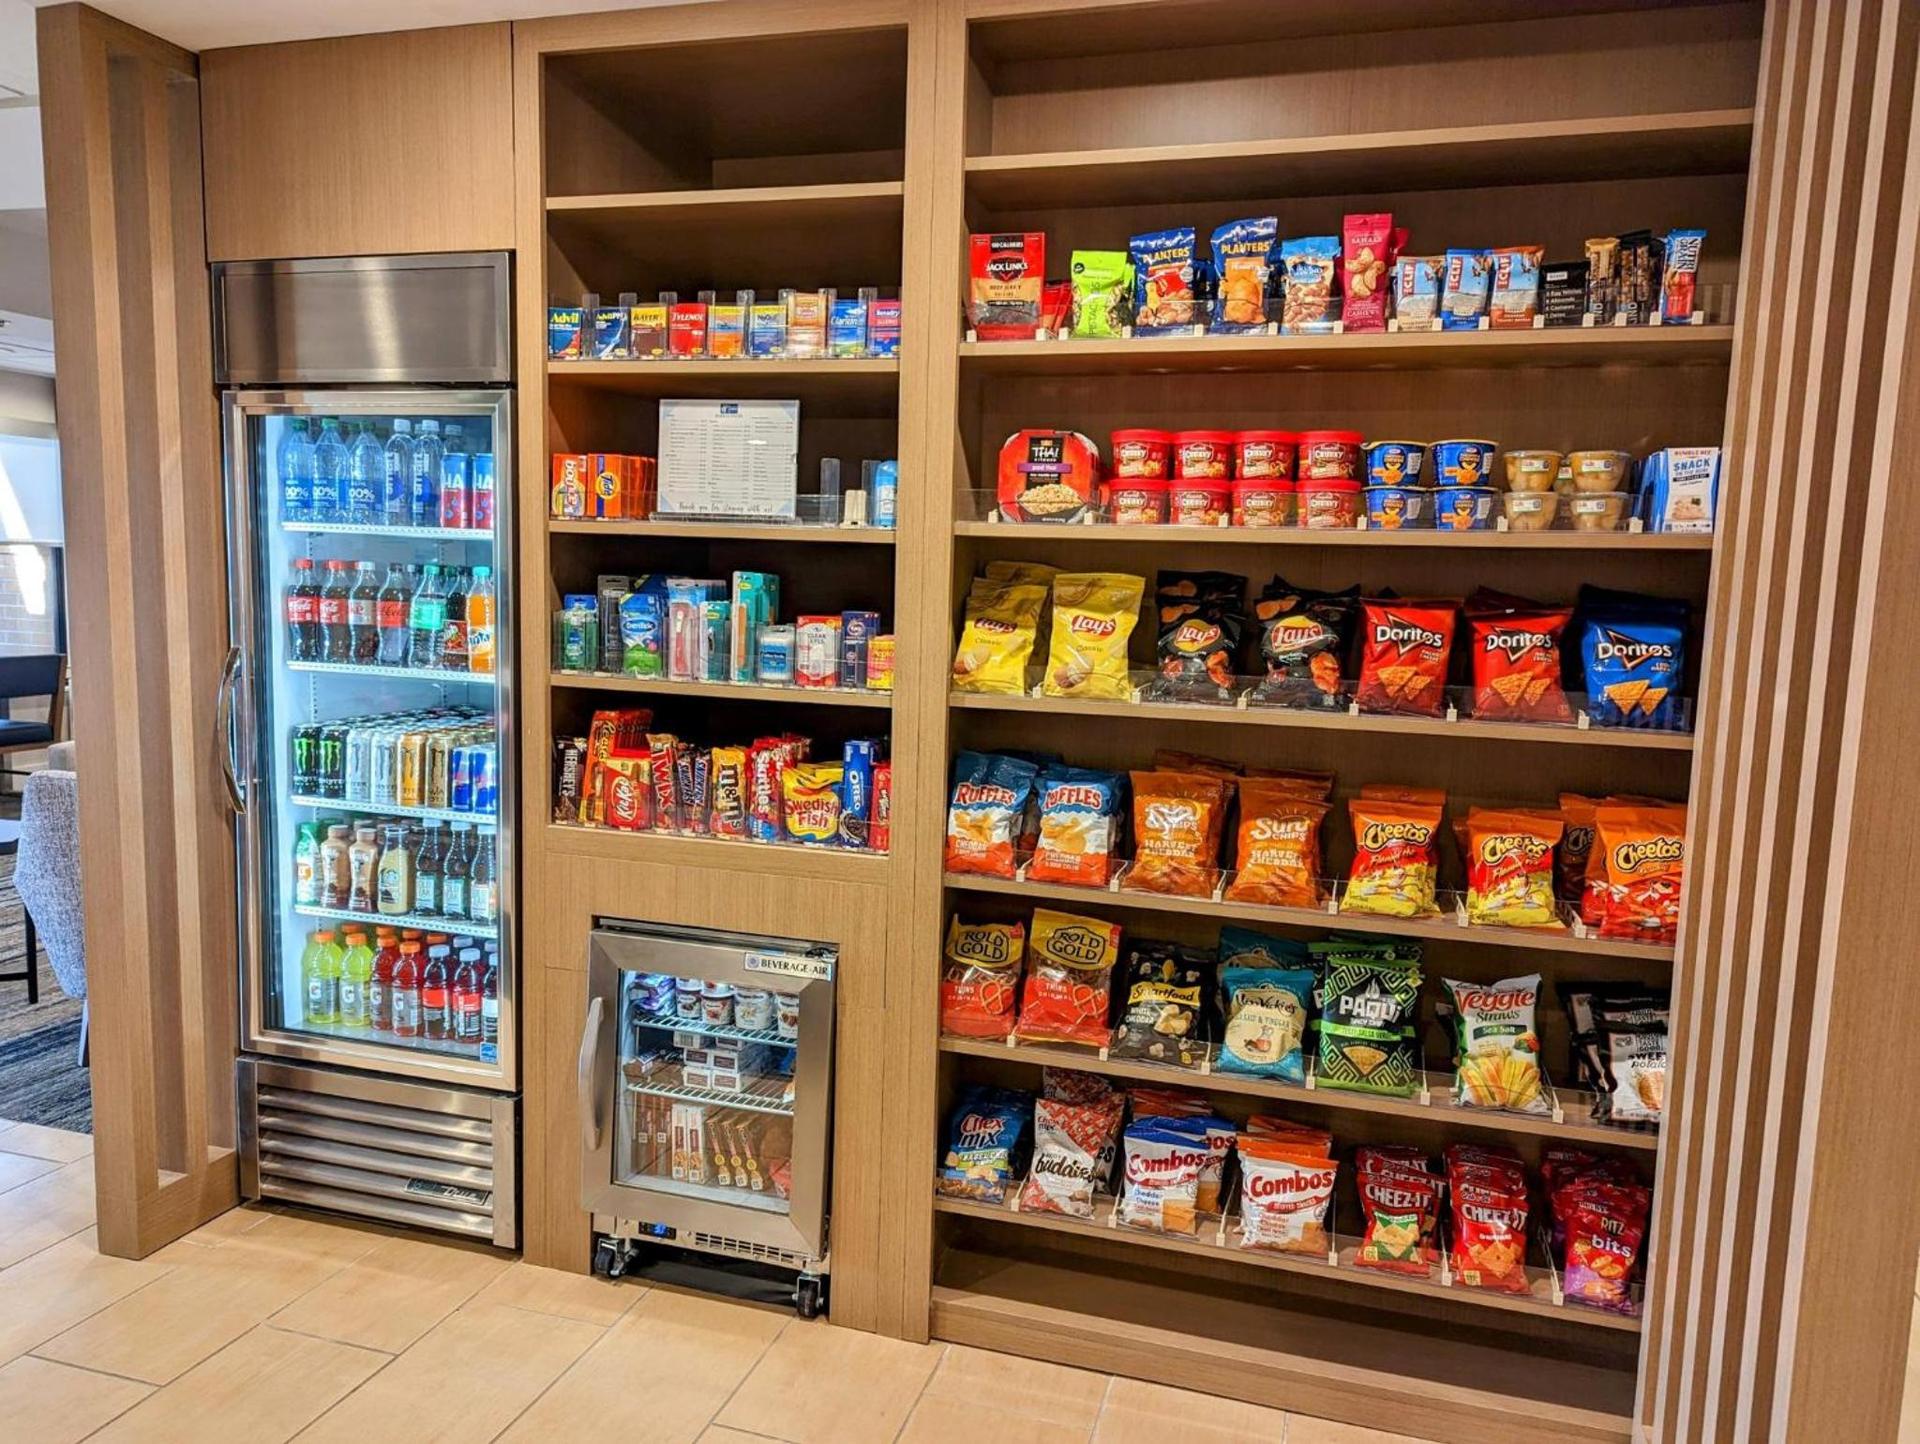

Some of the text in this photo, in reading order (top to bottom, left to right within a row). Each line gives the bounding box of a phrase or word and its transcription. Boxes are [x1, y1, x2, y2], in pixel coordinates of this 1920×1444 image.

[1142, 247, 1190, 263] PLANTERS
[1221, 241, 1270, 255] PLANTERS
[550, 312, 580, 323] Advil
[876, 309, 901, 318] Benadry
[1673, 458, 1710, 471] SNACK
[600, 473, 614, 496] Tide
[1072, 614, 1117, 634] Lay's
[1176, 624, 1220, 642] Lay's
[1375, 625, 1443, 648] Doritos
[1486, 631, 1552, 651] Doritos
[1598, 641, 1673, 660] Doritos
[562, 748, 578, 797] HERSHEY'S
[651, 748, 675, 809] TWIX
[756, 749, 770, 813] Skittles
[849, 770, 861, 811] OREO
[953, 782, 1017, 806] RUFFLES
[797, 811, 830, 829] Fish
[1250, 816, 1310, 841] Sun
[1364, 822, 1431, 851] Cheetos
[1482, 835, 1549, 865] Cheetos
[1616, 838, 1682, 872] Cheetos
[964, 930, 1004, 947] ROLD
[1057, 930, 1101, 949] ROLD
[960, 942, 1003, 959] GOLD
[1051, 941, 1098, 960] GOLD
[341, 985, 355, 1004] G
[1455, 987, 1536, 1016] Veggie
[962, 1115, 1005, 1133] Chex
[958, 1131, 999, 1149] mix
[1129, 1149, 1207, 1176] Combos
[1250, 1169, 1334, 1198] Combos
[1365, 1183, 1432, 1208] CHEEZ-IT
[1601, 1216, 1626, 1235] RITZ
[1591, 1234, 1633, 1258] bits
